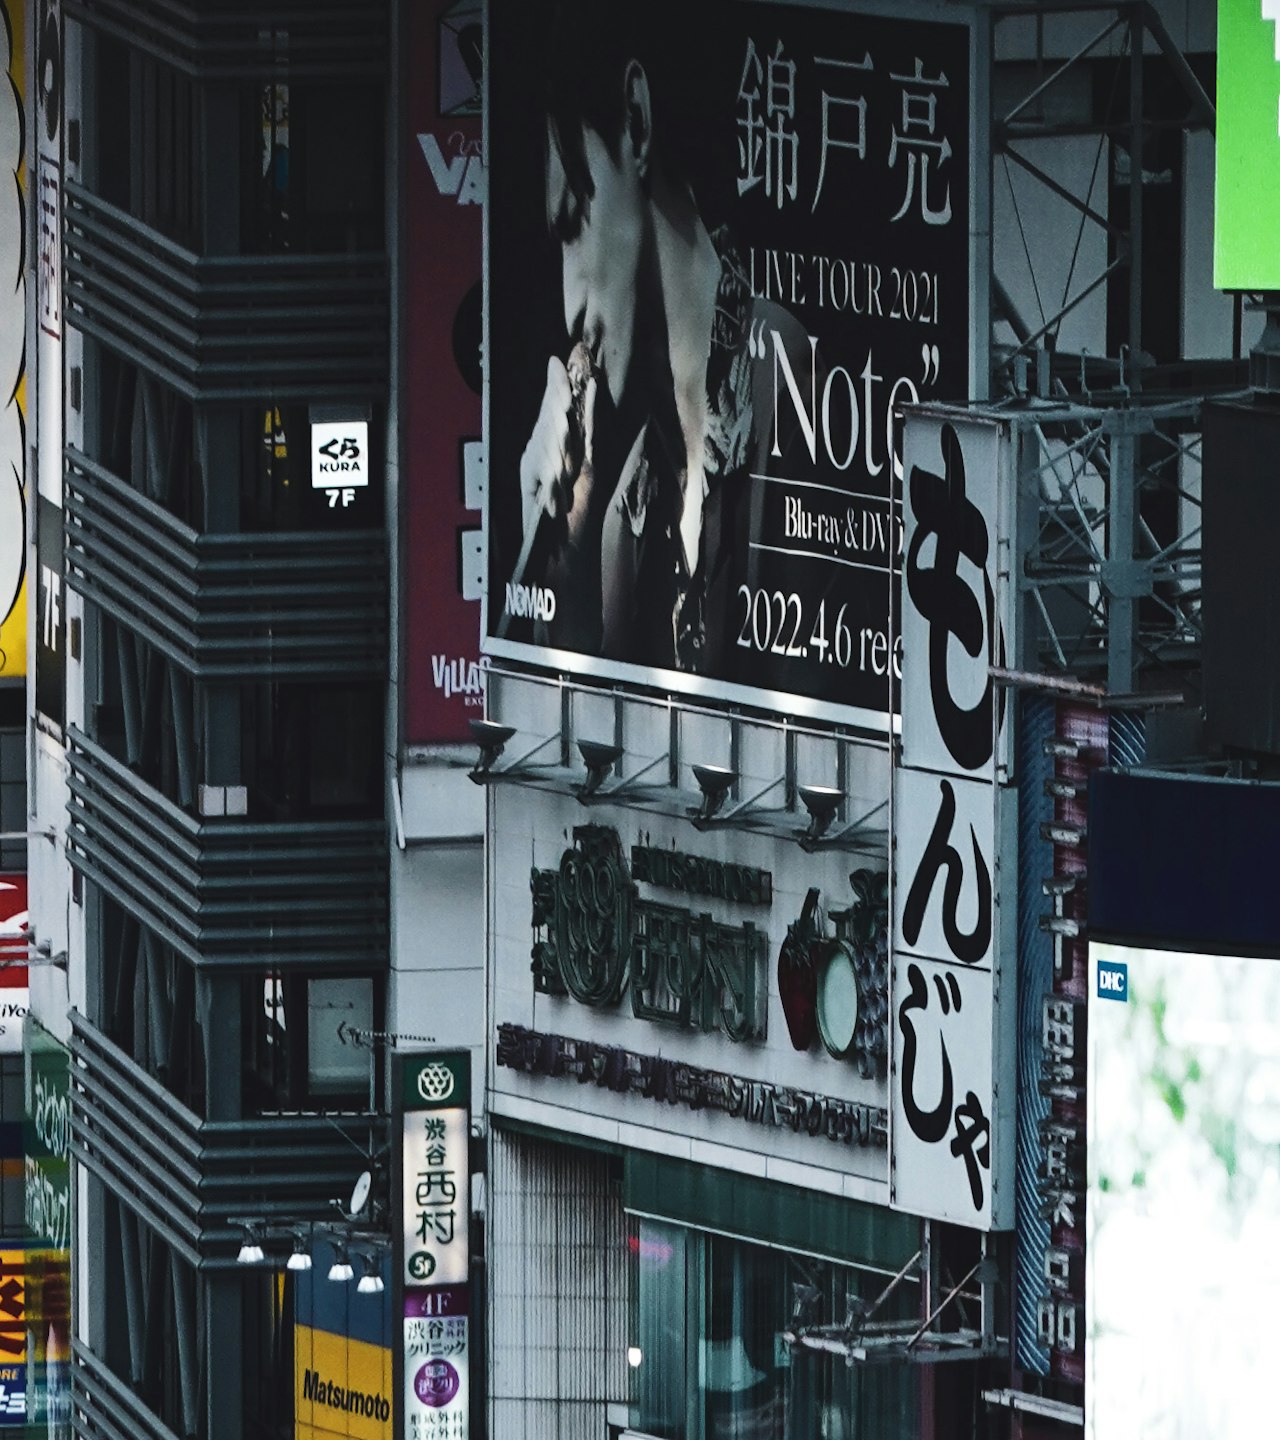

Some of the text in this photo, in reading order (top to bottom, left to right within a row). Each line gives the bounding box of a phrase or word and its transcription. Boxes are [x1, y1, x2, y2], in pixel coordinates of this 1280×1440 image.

[736, 37, 953, 225] 錦戸亮
[749, 246, 940, 326] LIVE TOUR 2021
[318, 437, 360, 460] くら
[319, 462, 361, 473] KURA
[324, 489, 357, 508] 7F
[783, 494, 843, 555] Blu-ray
[504, 581, 557, 623] NOMAD
[736, 584, 851, 669] 2022.4.6
[1099, 971, 1125, 992] DHC
[421, 1292, 452, 1316] 4F
[409, 1341, 467, 1357] クリニック
[303, 1369, 391, 1424] Matsumoto
